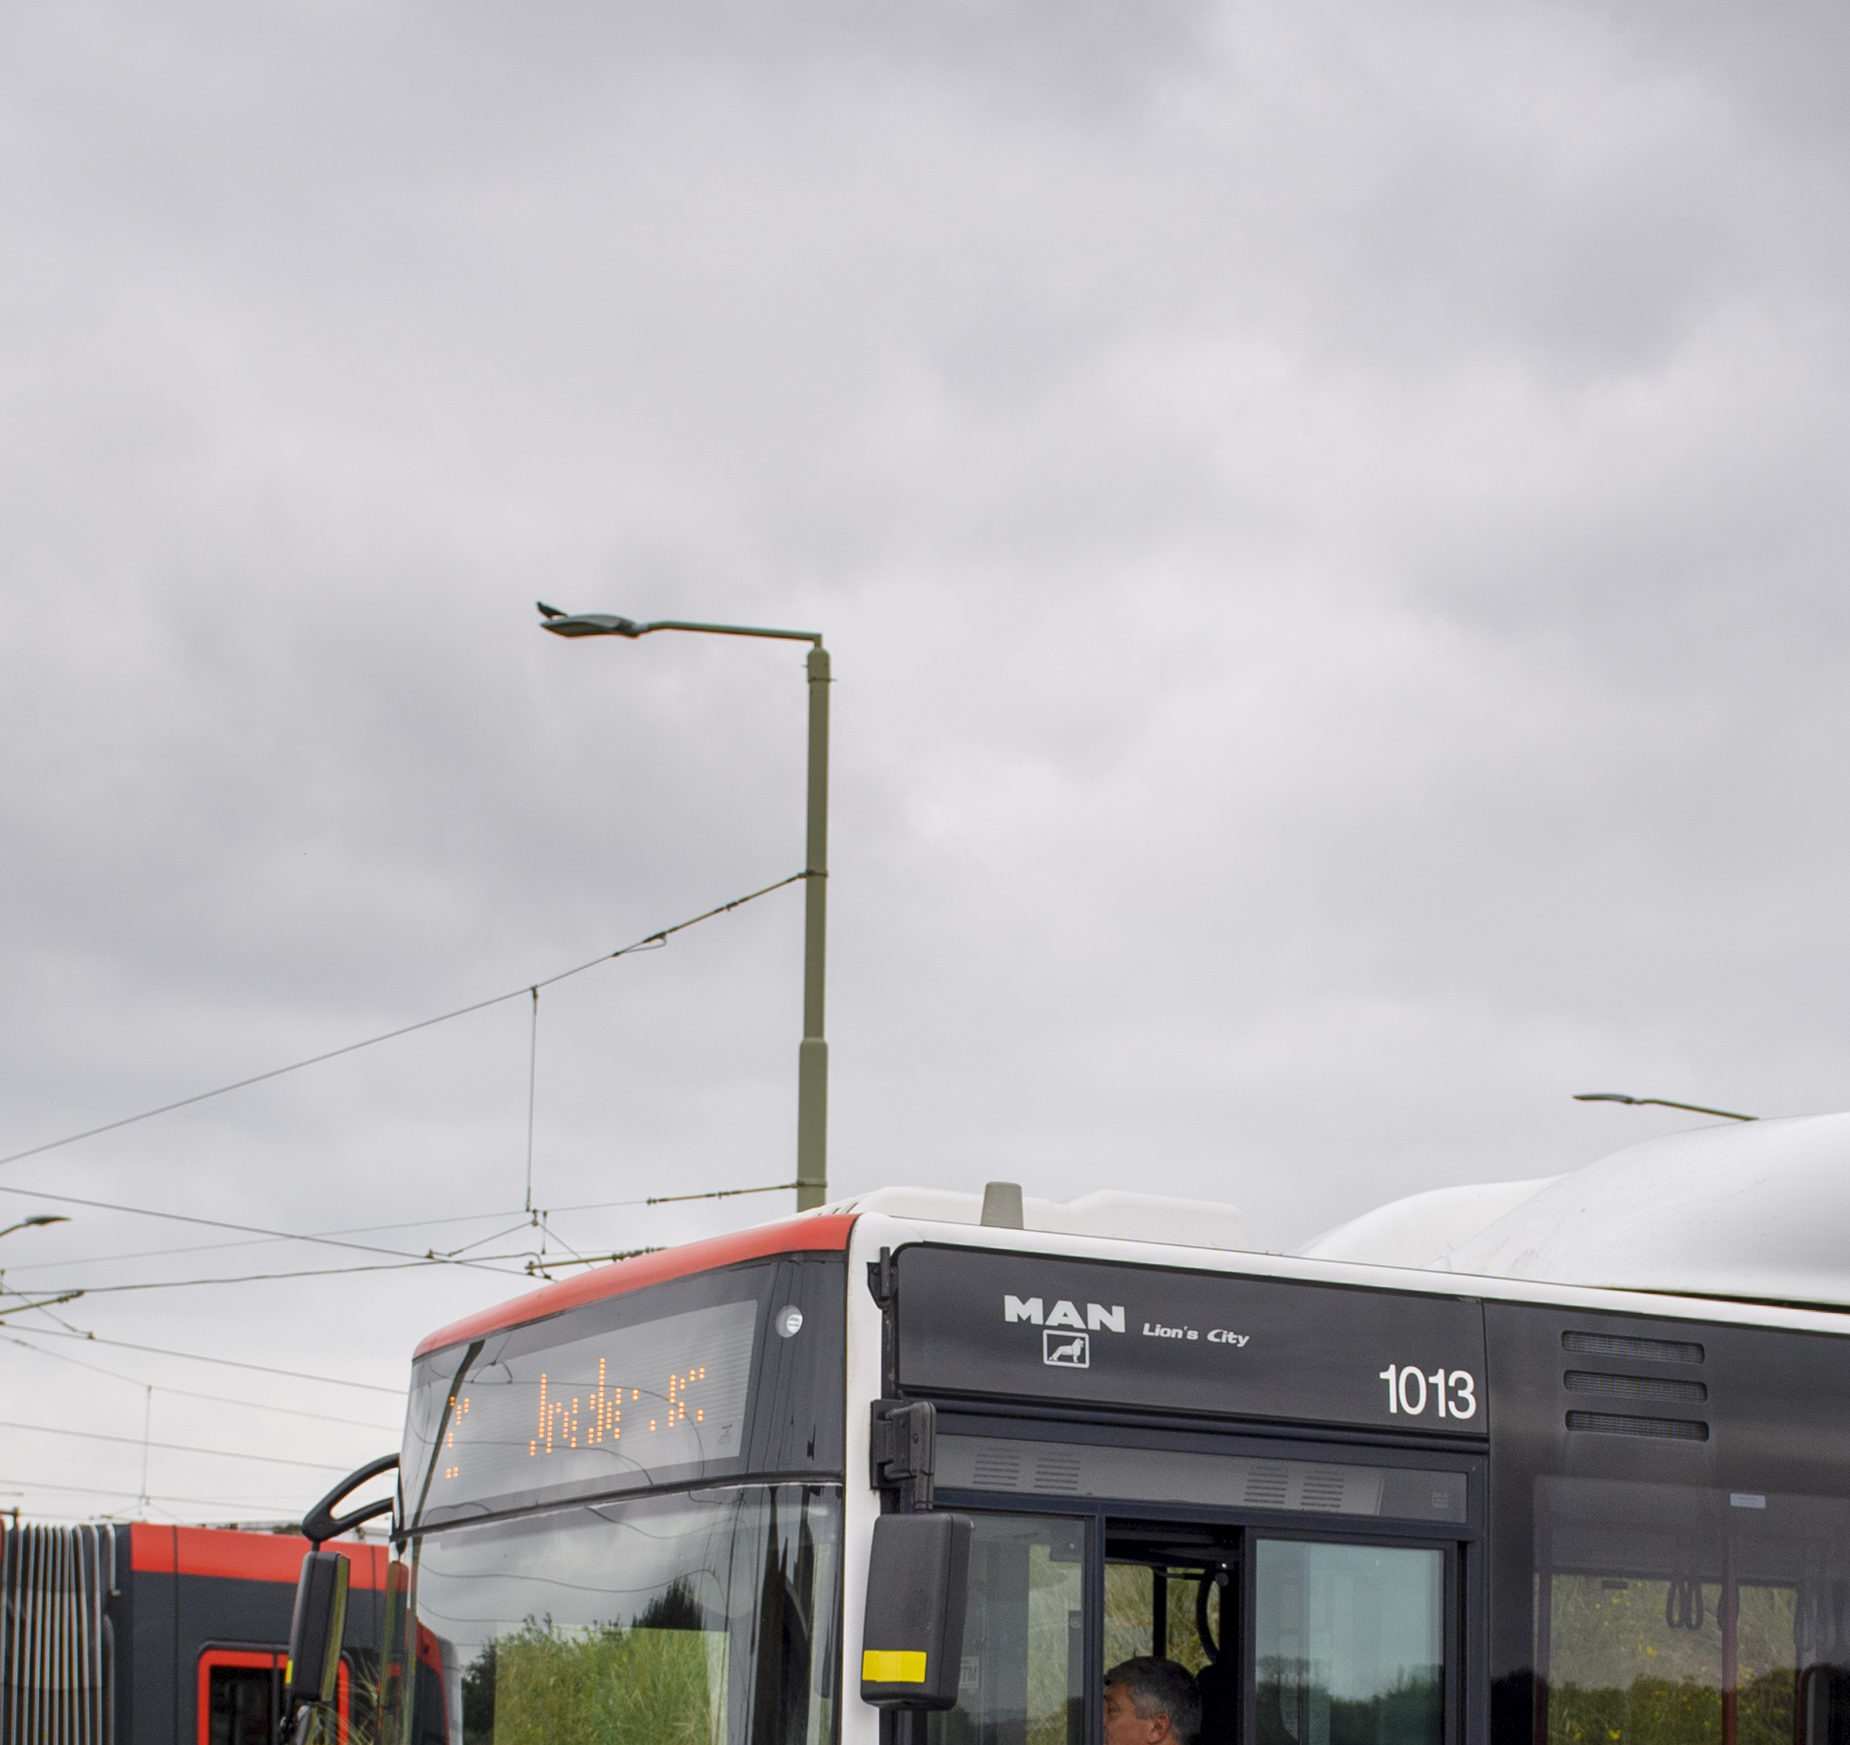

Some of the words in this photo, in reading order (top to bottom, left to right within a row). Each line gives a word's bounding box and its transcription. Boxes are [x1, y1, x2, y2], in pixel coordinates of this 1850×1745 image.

[1004, 1295, 1126, 1333] MAN
[1142, 1322, 1199, 1341] Lion's
[1207, 1328, 1250, 1348] City
[1379, 1363, 1477, 1420] 1013
